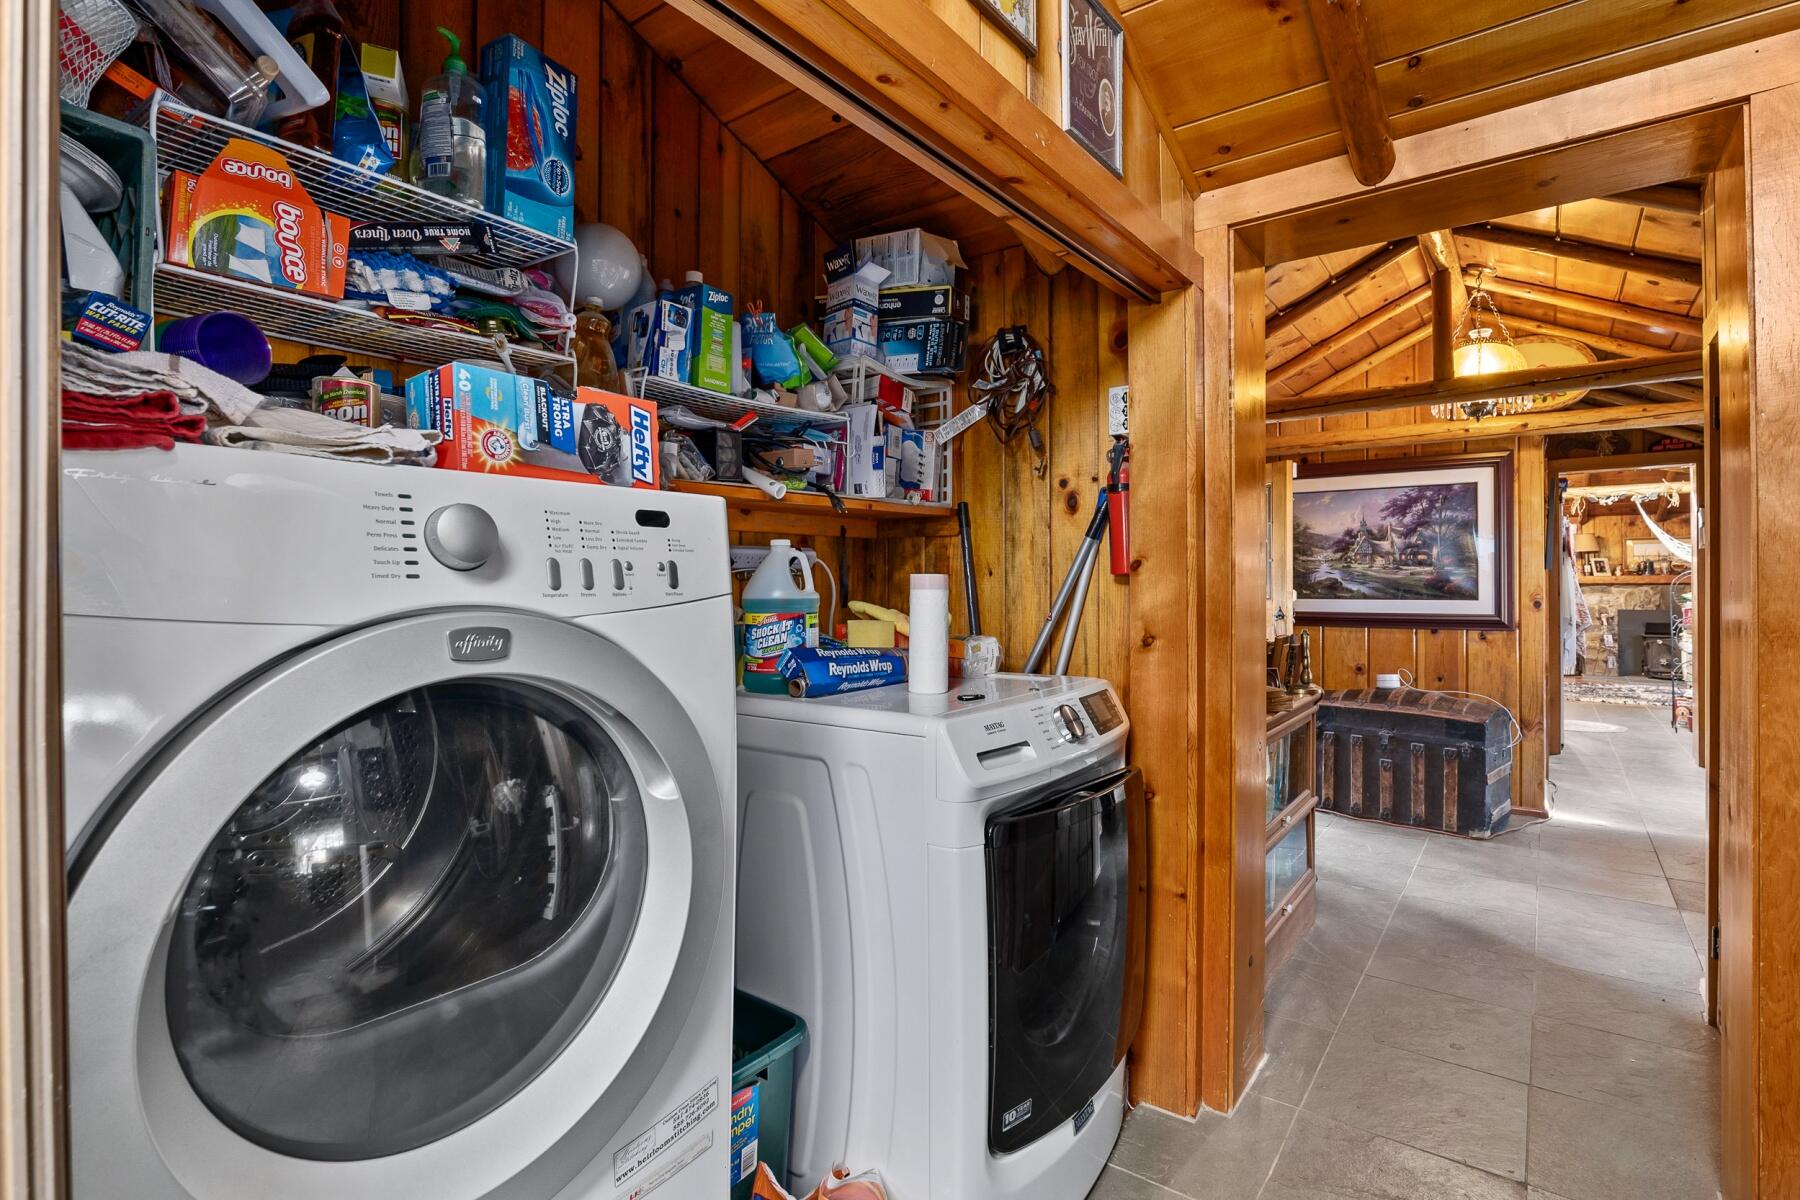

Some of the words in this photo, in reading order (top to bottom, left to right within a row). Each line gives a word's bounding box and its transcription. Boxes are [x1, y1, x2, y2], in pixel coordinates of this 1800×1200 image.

[544, 63, 570, 138] Ziploc
[224, 159, 292, 189] bounce
[354, 226, 391, 242] Liners
[393, 228, 422, 241] Oven
[424, 228, 448, 237] TRUE
[450, 227, 471, 237] HOME
[275, 202, 306, 284] bounce
[708, 290, 729, 303] Ziploc
[880, 301, 901, 309] enhan
[85, 309, 107, 321] WAX
[107, 319, 138, 335] PAPER
[458, 368, 471, 391] 40
[539, 386, 548, 431] BLACKOUT
[552, 396, 563, 437] TRONG
[561, 398, 571, 429] LTRA
[633, 409, 650, 480] Hefty
[362, 504, 380, 512] Heavy
[751, 623, 780, 640] SHOCK
[781, 619, 793, 632] IT
[455, 633, 503, 654] affinity
[757, 632, 788, 649] CLEAN
[815, 648, 859, 658] Reynolds
[828, 661, 871, 679] Reynolds
[870, 659, 893, 673] Wrap
[983, 721, 1005, 732] MAYTAG
[731, 1103, 755, 1123] ndry
[1004, 1110, 1017, 1125] 10
[731, 1113, 756, 1138] per
[615, 1100, 716, 1183] www.heirloomstitching.com
